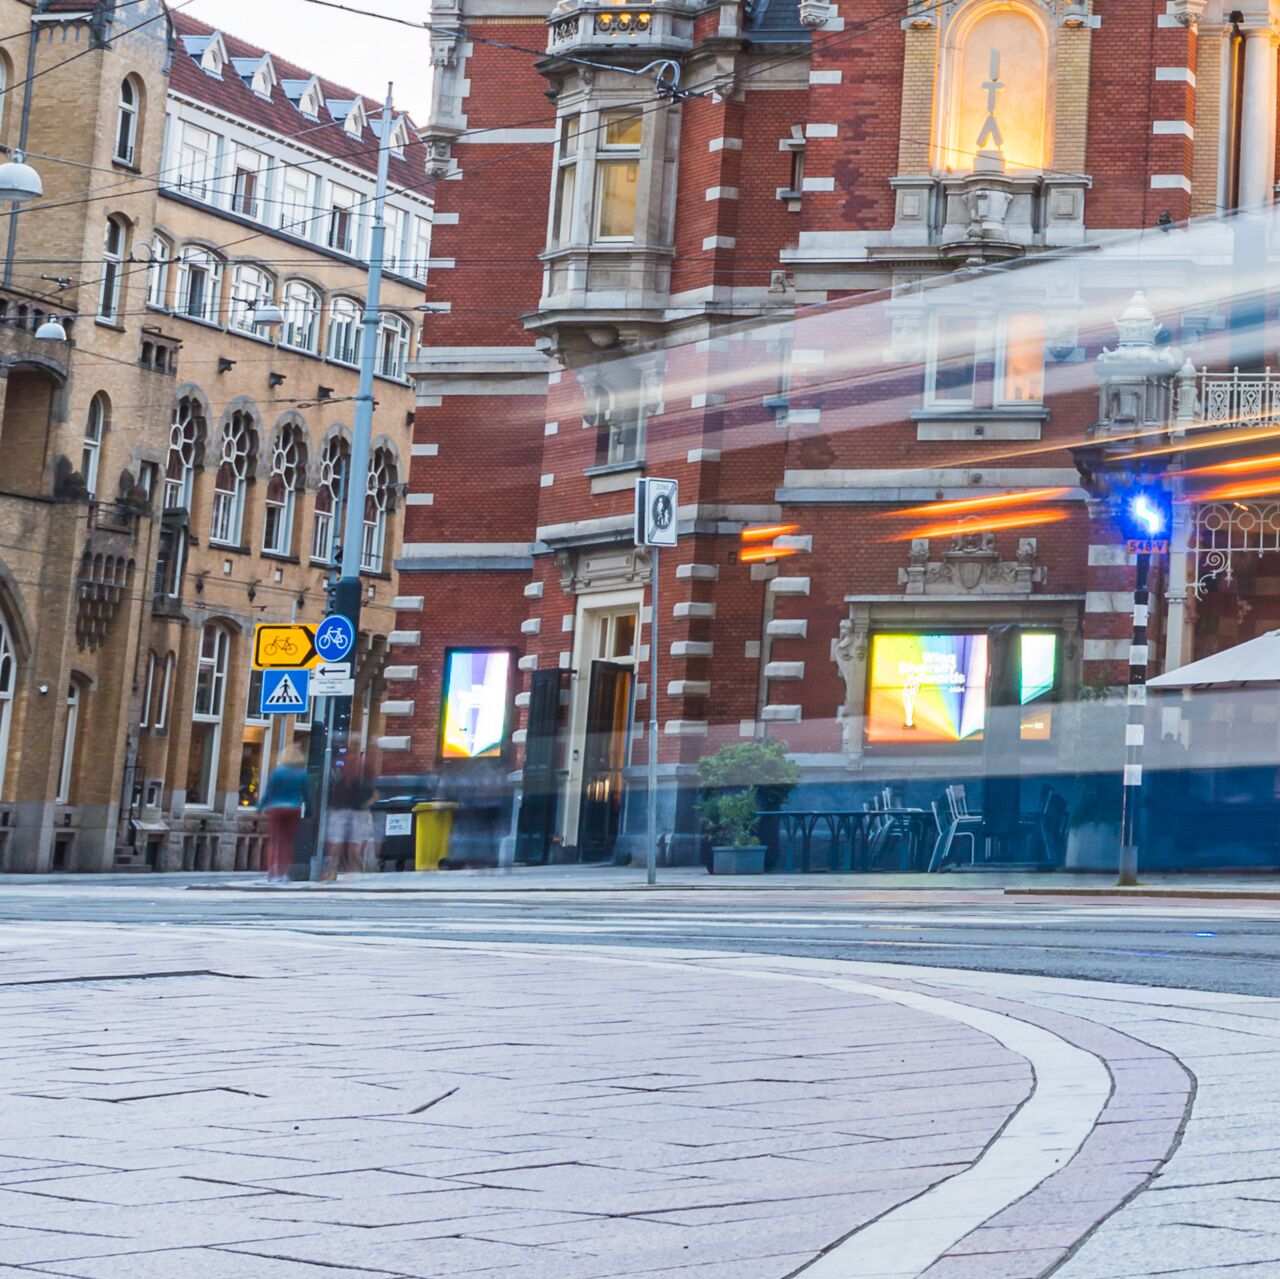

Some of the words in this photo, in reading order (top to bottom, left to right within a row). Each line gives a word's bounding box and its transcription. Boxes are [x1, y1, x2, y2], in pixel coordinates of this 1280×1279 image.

[976, 49, 1004, 146] ITA
[899, 661, 957, 675] Diversity
[917, 671, 966, 684] Awards
